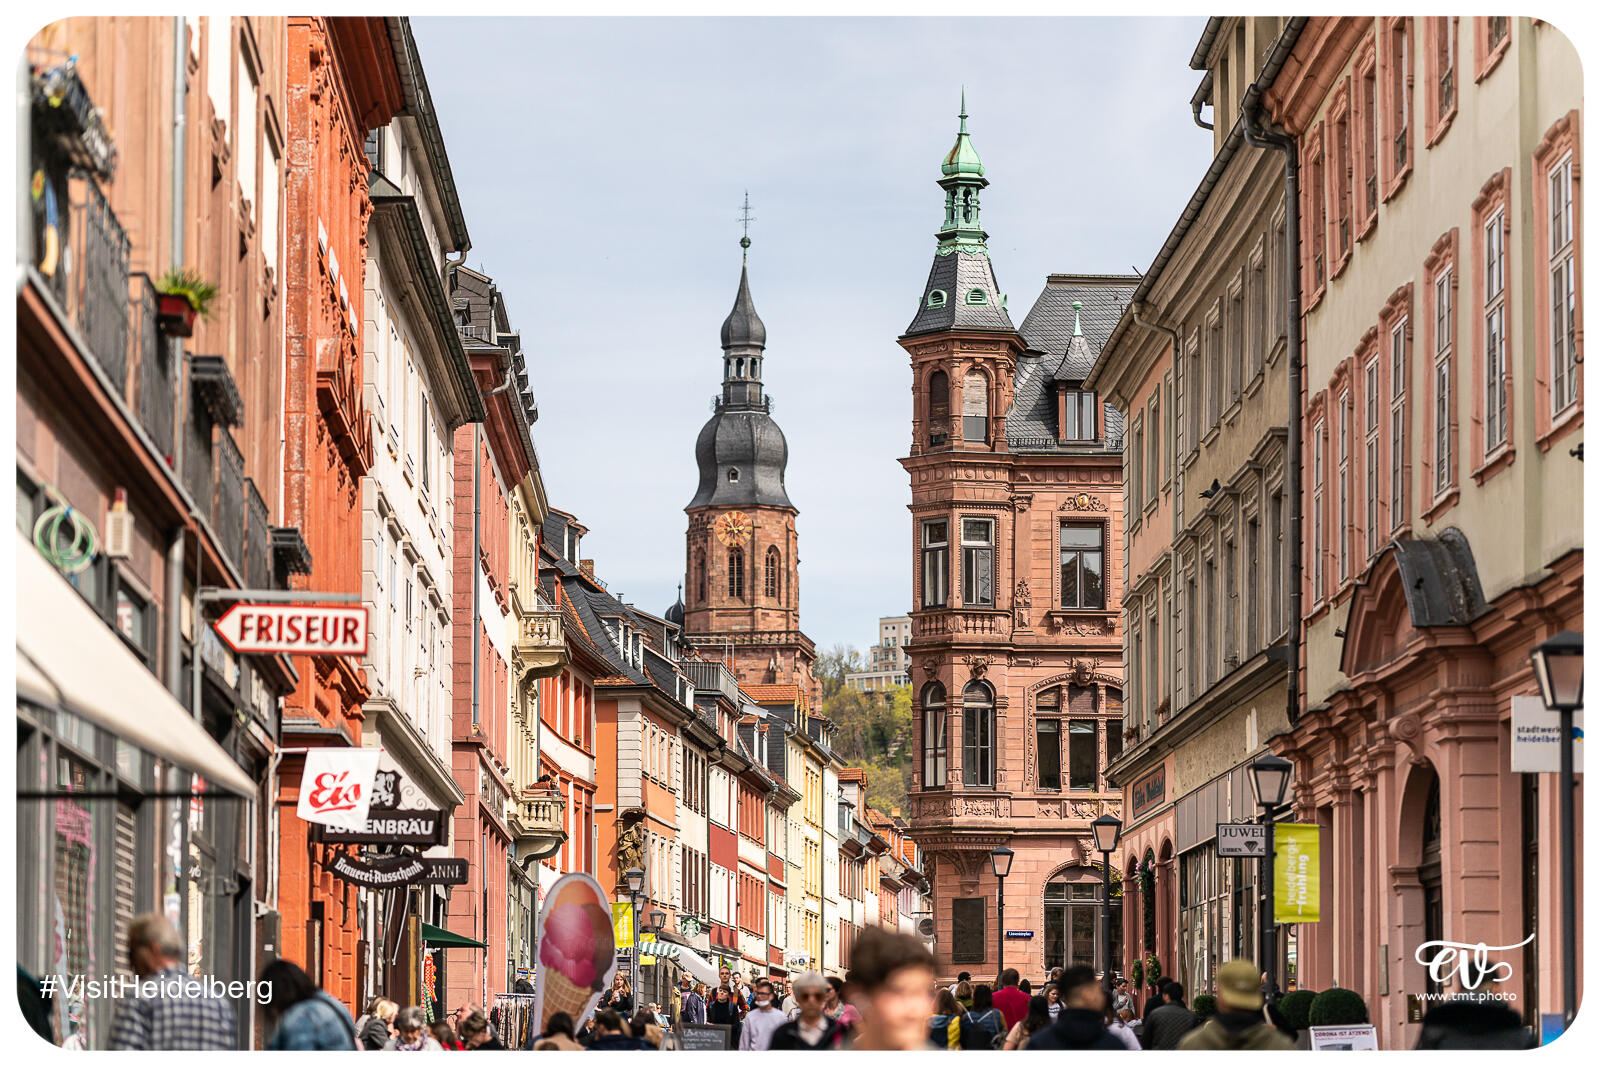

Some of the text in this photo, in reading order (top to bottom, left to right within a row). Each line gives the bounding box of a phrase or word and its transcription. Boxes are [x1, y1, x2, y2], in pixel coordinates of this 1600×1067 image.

[239, 613, 360, 645] FRISEUR
[308, 770, 362, 809] Eis
[334, 857, 425, 884] Brauerei-Ausschank
